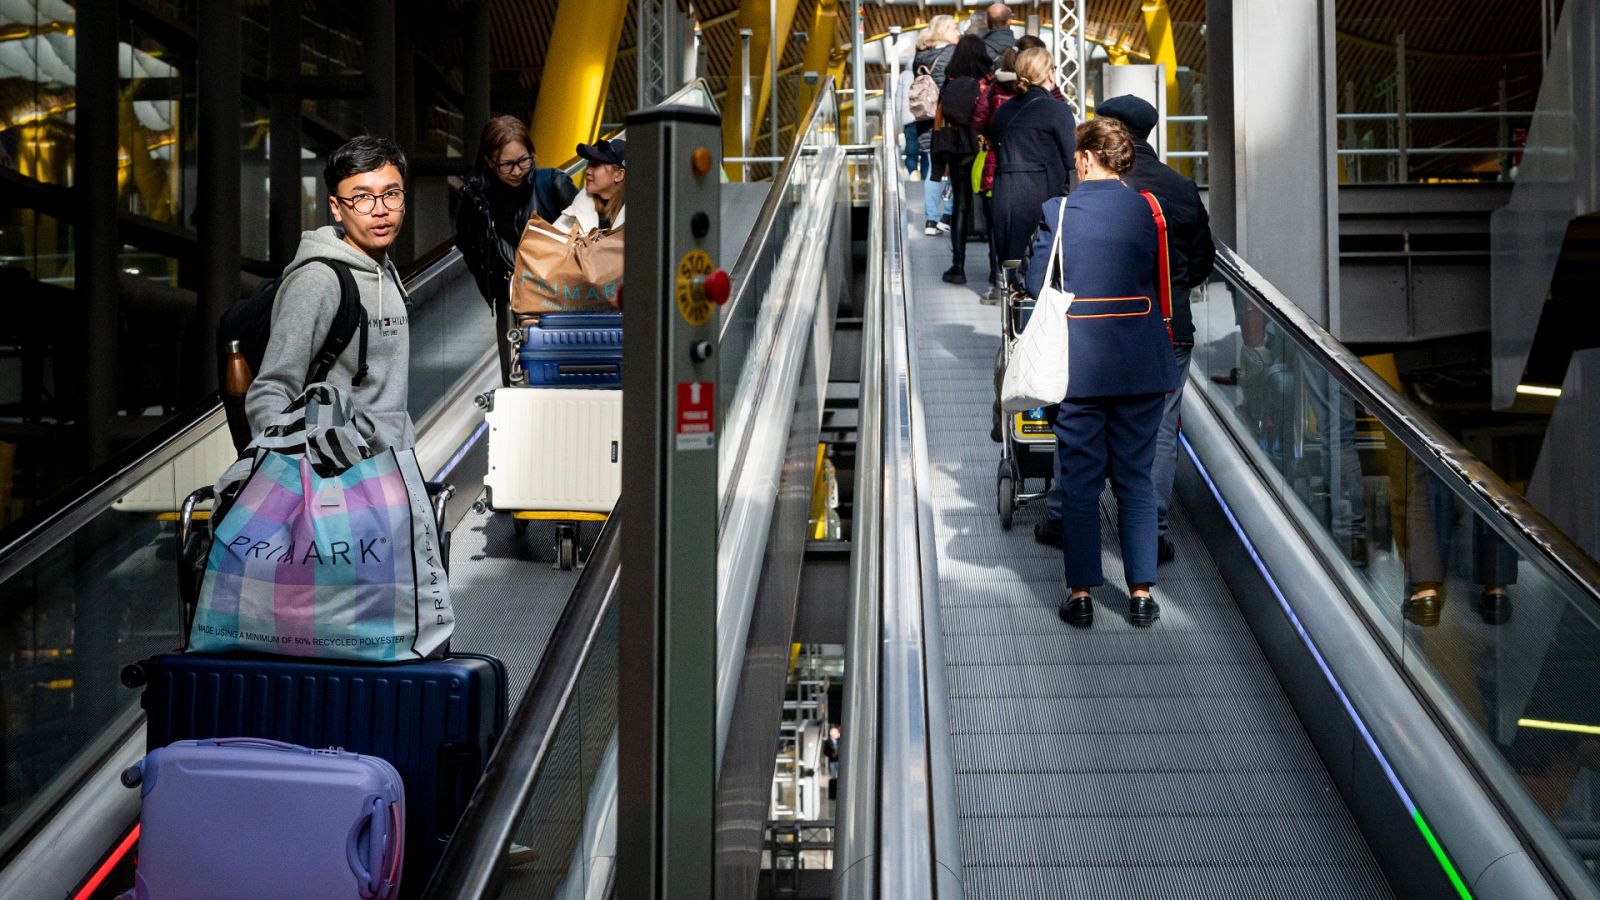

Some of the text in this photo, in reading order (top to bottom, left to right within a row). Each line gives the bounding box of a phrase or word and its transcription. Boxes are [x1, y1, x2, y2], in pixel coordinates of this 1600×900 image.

[198, 624, 214, 635] MADE
[215, 628, 239, 638] USING
[240, 631, 245, 639] A
[245, 632, 280, 643] MINIMUM
[281, 636, 294, 644] OF
[312, 637, 358, 647] RECYCLED
[359, 635, 405, 646] POLYESTER
